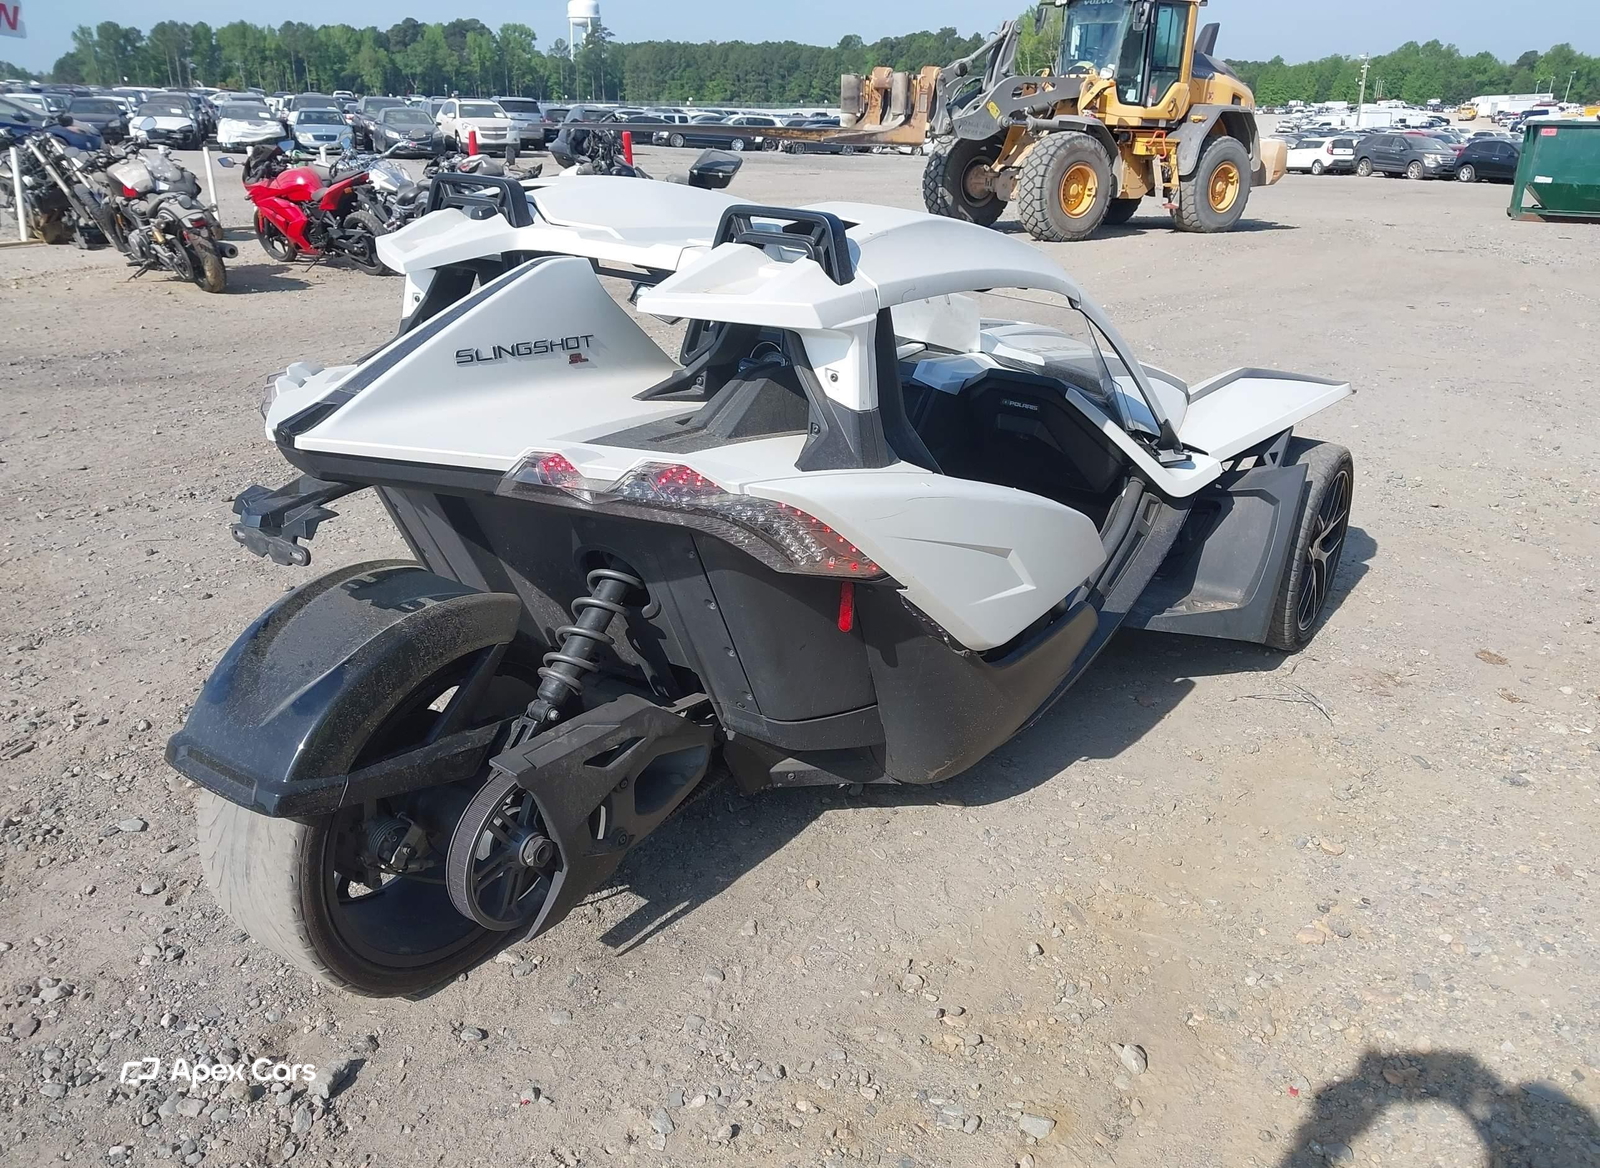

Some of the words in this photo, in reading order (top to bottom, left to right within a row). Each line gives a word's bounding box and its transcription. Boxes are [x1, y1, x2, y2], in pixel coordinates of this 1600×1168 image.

[454, 334, 594, 364] SLINGSHOT
[568, 352, 589, 364] SL
[1009, 400, 1038, 411] POLARIS
